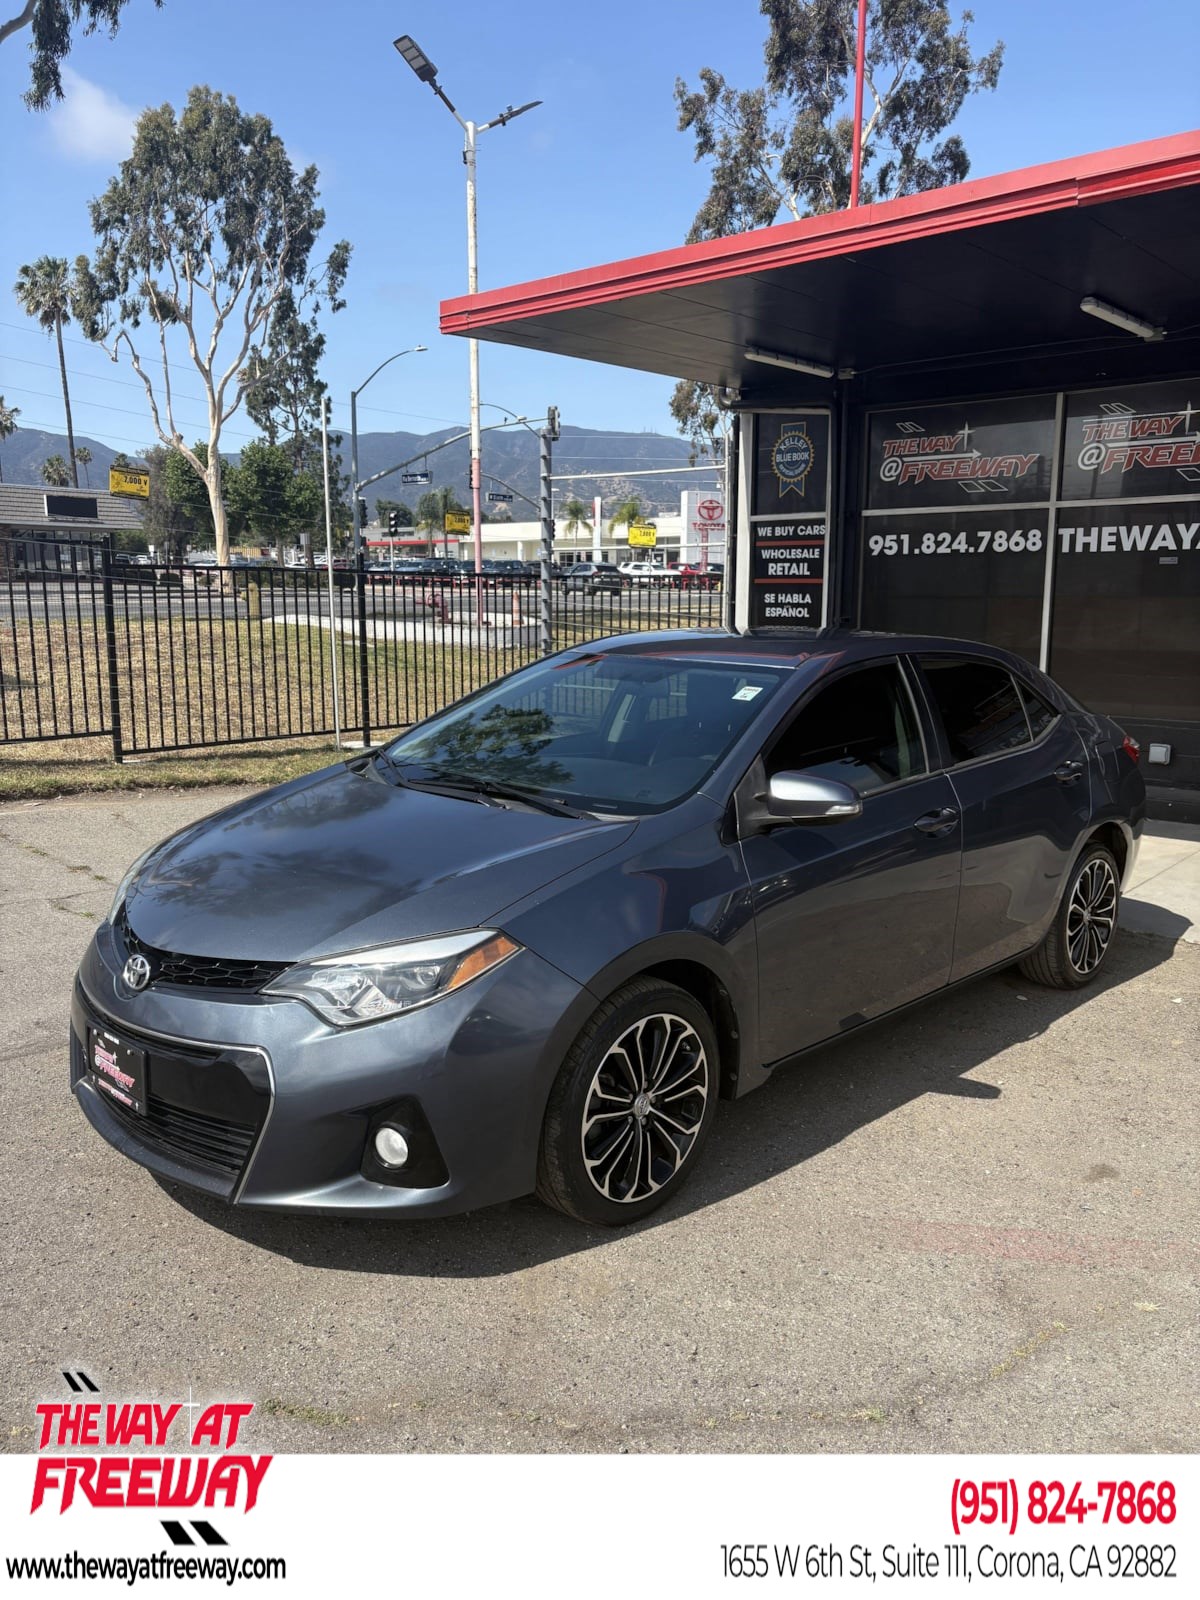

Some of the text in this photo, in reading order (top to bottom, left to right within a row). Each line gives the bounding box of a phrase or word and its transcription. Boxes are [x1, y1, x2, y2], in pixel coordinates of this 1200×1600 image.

[1082, 415, 1185, 445] THE WAY
[780, 437, 808, 451] KELLEY
[883, 434, 964, 459] THE WAY
[776, 451, 810, 463] BLUE BOOK
[1077, 441, 1200, 475] @FREE
[692, 522, 726, 531] TOYOTA
[757, 525, 826, 537] WE BUY CARS
[868, 528, 1043, 557] 951.824.7868
[1058, 522, 1200, 553] THEWAY
[761, 548, 821, 559] WHOLESALE
[768, 562, 811, 576] RETAIL
[764, 593, 812, 604] SE HABLA
[765, 605, 810, 618] ESPAÑOL
